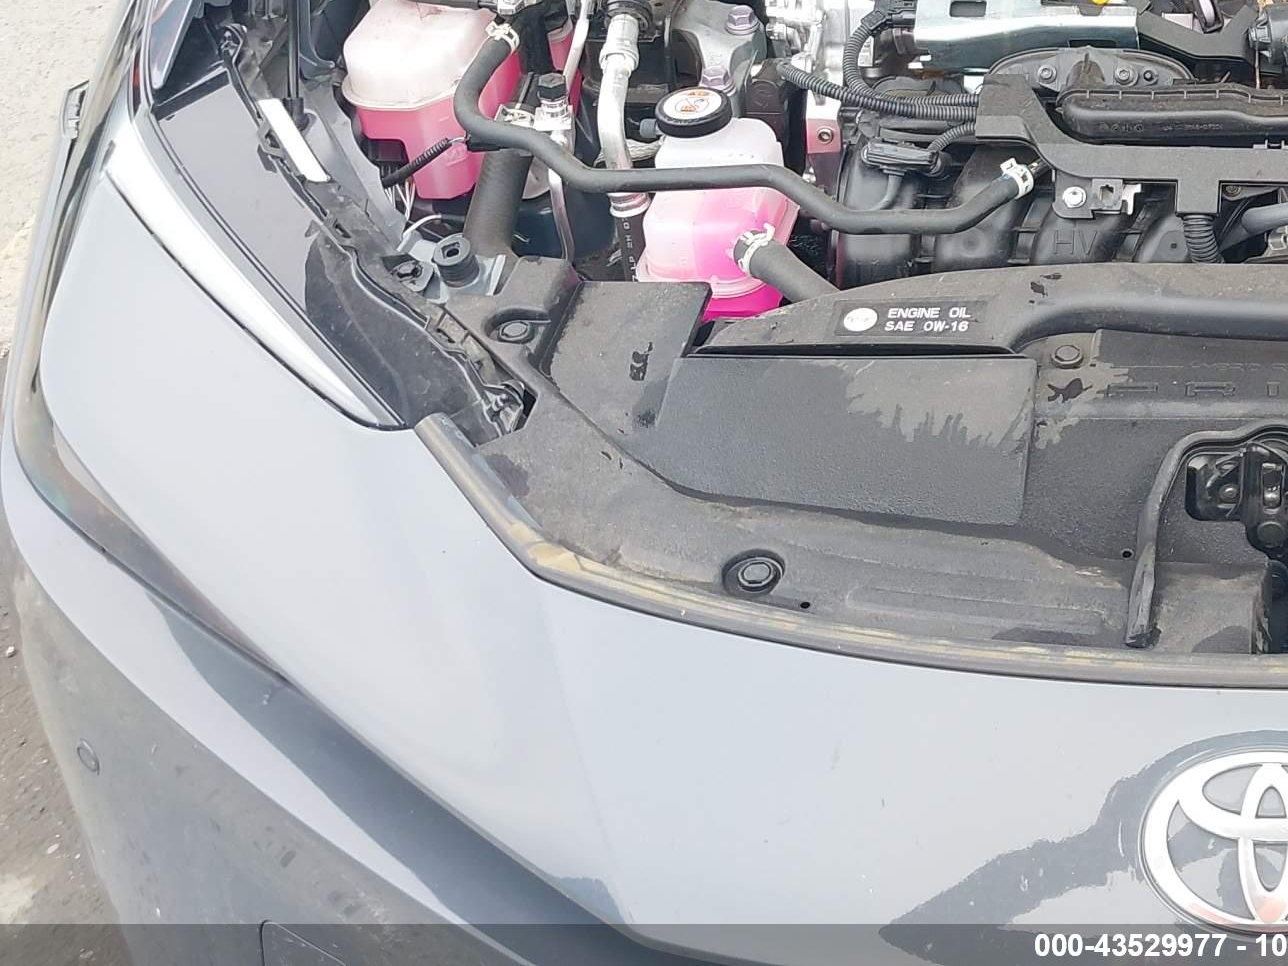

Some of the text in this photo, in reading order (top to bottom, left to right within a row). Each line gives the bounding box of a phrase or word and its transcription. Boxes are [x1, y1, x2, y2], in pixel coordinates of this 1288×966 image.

[1053, 229, 1098, 255] HV
[888, 307, 971, 318] ENGINE OIL
[884, 320, 969, 331] SAE 0W-16
